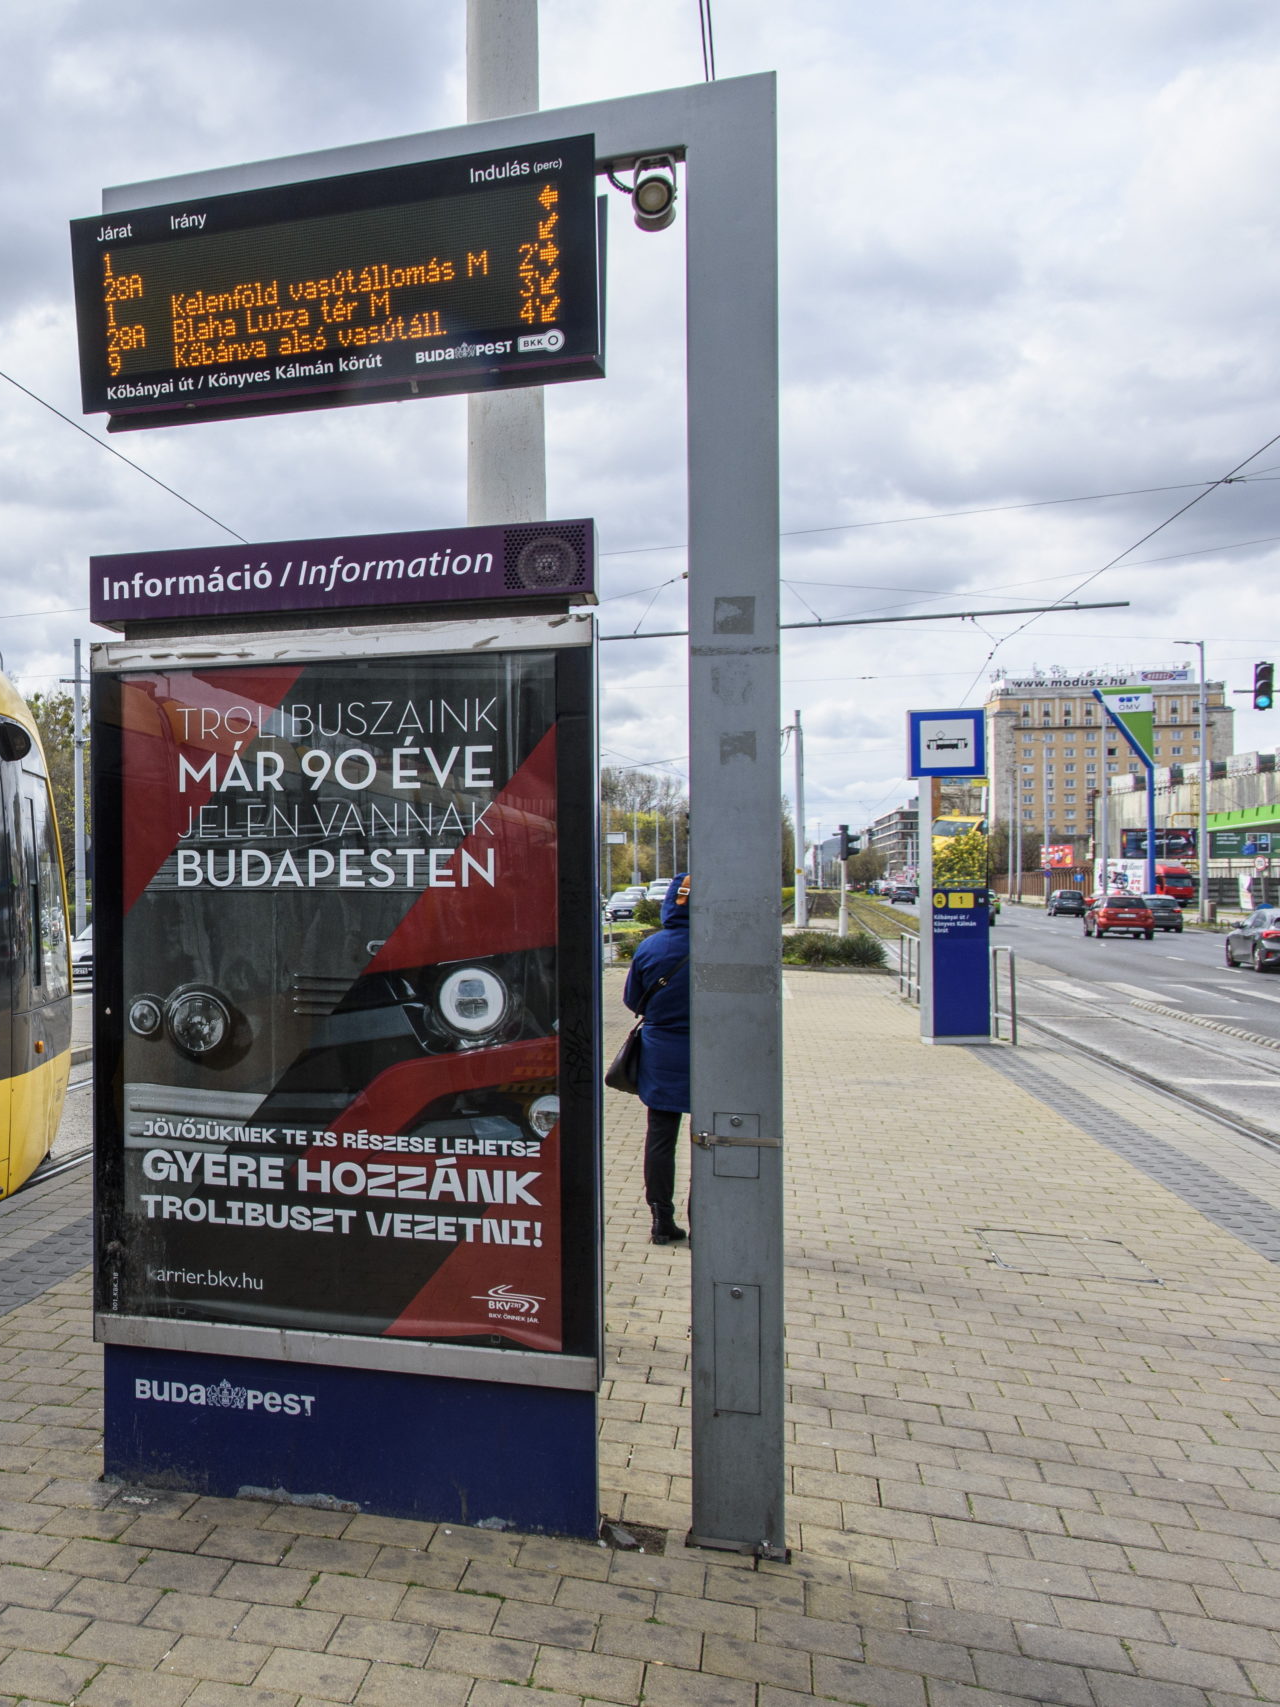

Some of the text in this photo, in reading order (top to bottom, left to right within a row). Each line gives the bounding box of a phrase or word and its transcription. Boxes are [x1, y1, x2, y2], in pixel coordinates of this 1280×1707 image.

[469, 157, 563, 184] Indulás (perc)
[97, 223, 132, 241] Járat
[170, 213, 207, 231] Irány
[103, 252, 113, 277] 1
[103, 273, 143, 302] 28A
[107, 303, 117, 327] 1
[171, 279, 278, 318] Kelenföld
[288, 257, 455, 301] vasútállomás
[467, 250, 488, 277] M
[106, 324, 146, 352] 28A
[173, 314, 237, 343] Blaha
[246, 305, 310, 334] Lujza
[320, 297, 358, 323] tér
[370, 291, 390, 317] M
[107, 352, 122, 377] 9
[278, 326, 327, 355] alsó
[337, 311, 448, 347] vasútáll.
[523, 338, 544, 349] BKK
[107, 378, 175, 401] Kőbányai
[178, 375, 194, 392] út
[208, 369, 271, 391] Könyves
[275, 360, 334, 381] Kálmán
[338, 352, 383, 374] körút
[103, 550, 494, 601] Információ / Information
[175, 696, 498, 741] TROLIBUSZAINK
[178, 736, 494, 793] MÁR 90 ÉVE
[177, 801, 495, 839] JELEN VANNAK
[176, 847, 495, 889] BUDAPESTEN
[142, 1117, 541, 1158] JÖVŐJÜKNEK TE IS RÉSZESE LEHETSZ
[141, 1149, 542, 1207] GYERE HOZZÁNK
[140, 1194, 543, 1249] TROLIBUSZT VEZETNI!
[145, 1265, 265, 1291] karrier.bkv.hu
[488, 1300, 511, 1311] BKV
